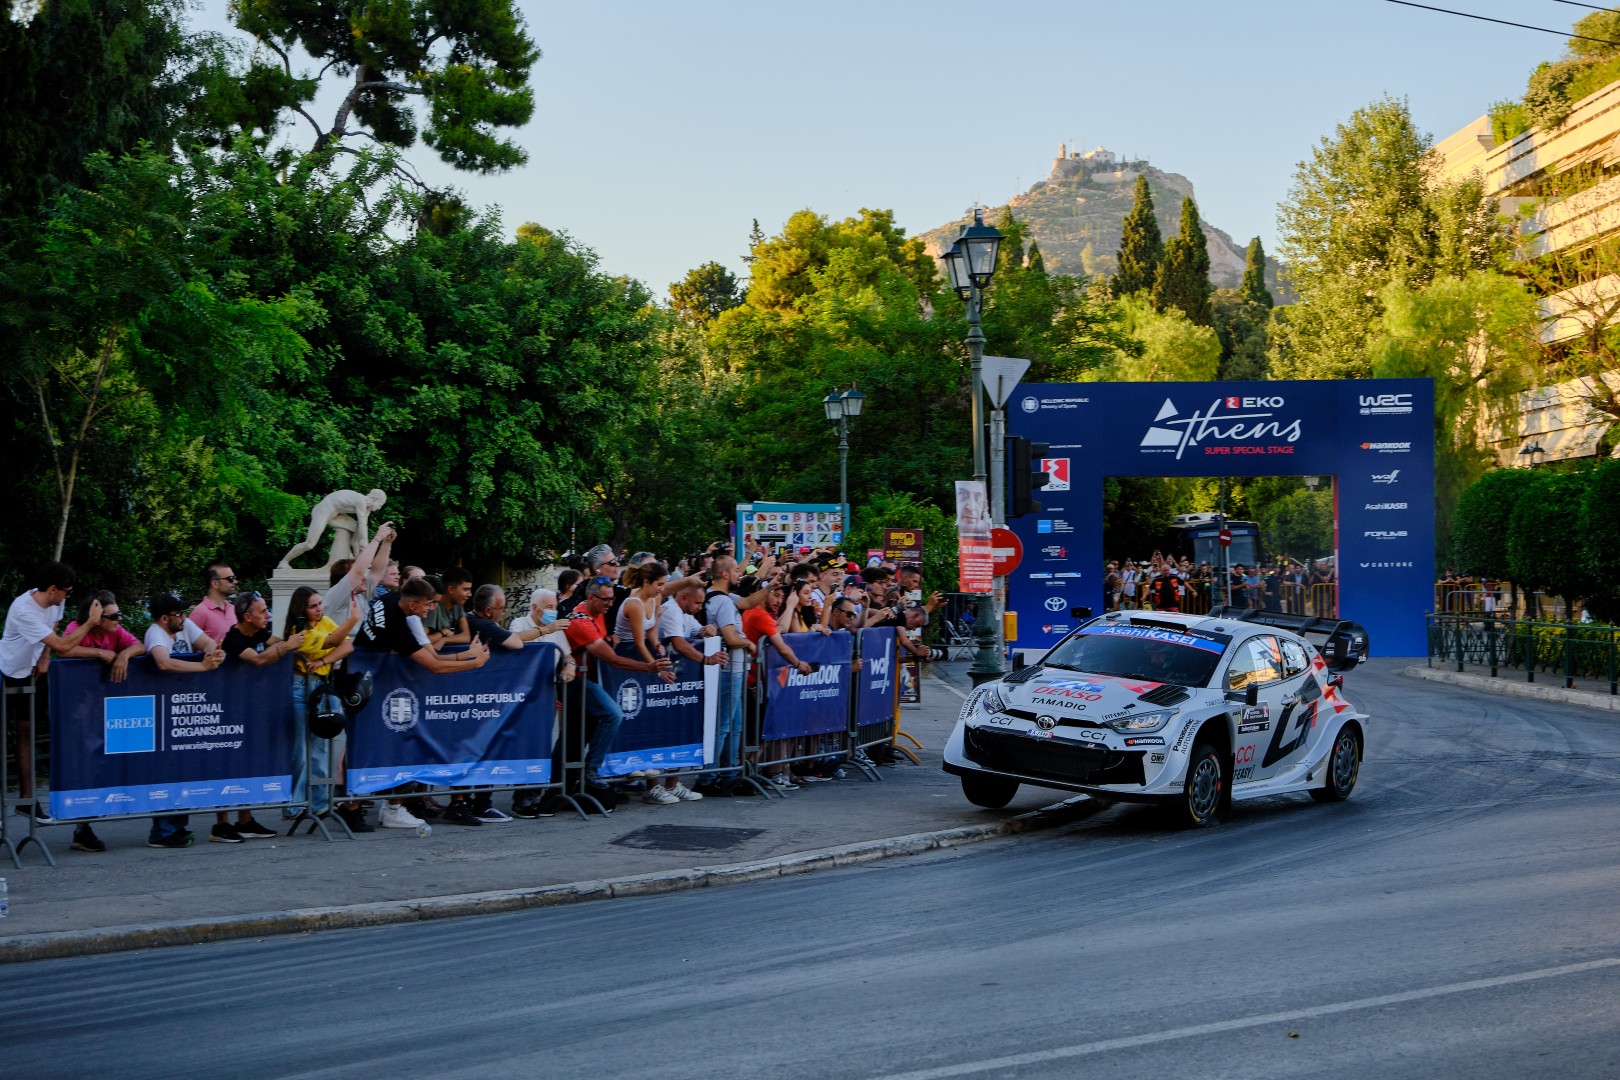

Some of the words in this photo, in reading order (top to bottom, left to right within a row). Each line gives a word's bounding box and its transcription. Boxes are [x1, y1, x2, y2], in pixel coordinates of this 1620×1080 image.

[1242, 396, 1285, 408] EKO
[1359, 393, 1413, 406] WRC
[1205, 447, 1231, 455] SUPER
[1232, 446, 1266, 454] SPECIAL
[1103, 627, 1198, 646] AsahiKASEI
[646, 683, 682, 694] HELLENIC
[799, 688, 818, 701] driving
[1032, 686, 1103, 702] DENSO
[170, 692, 207, 703] GREEK
[425, 694, 475, 706] HELLENIC
[475, 692, 526, 704] REPUBLIC
[646, 697, 671, 709] Ministry
[671, 696, 679, 706] of
[679, 695, 699, 706] Sports
[1031, 697, 1087, 711] TAMADIC
[170, 703, 225, 715] NATIONAL
[425, 709, 460, 721] Ministry
[460, 709, 471, 719] of
[471, 708, 501, 721] Sports
[105, 717, 154, 730] GREECE
[170, 714, 221, 727] TOURISM
[170, 725, 245, 738] ORGANISATION
[1080, 730, 1107, 741] CCi
[1172, 718, 1194, 752] Panasonic
[170, 740, 244, 751] www.visitgreece.gr
[1151, 754, 1165, 762] OMP
